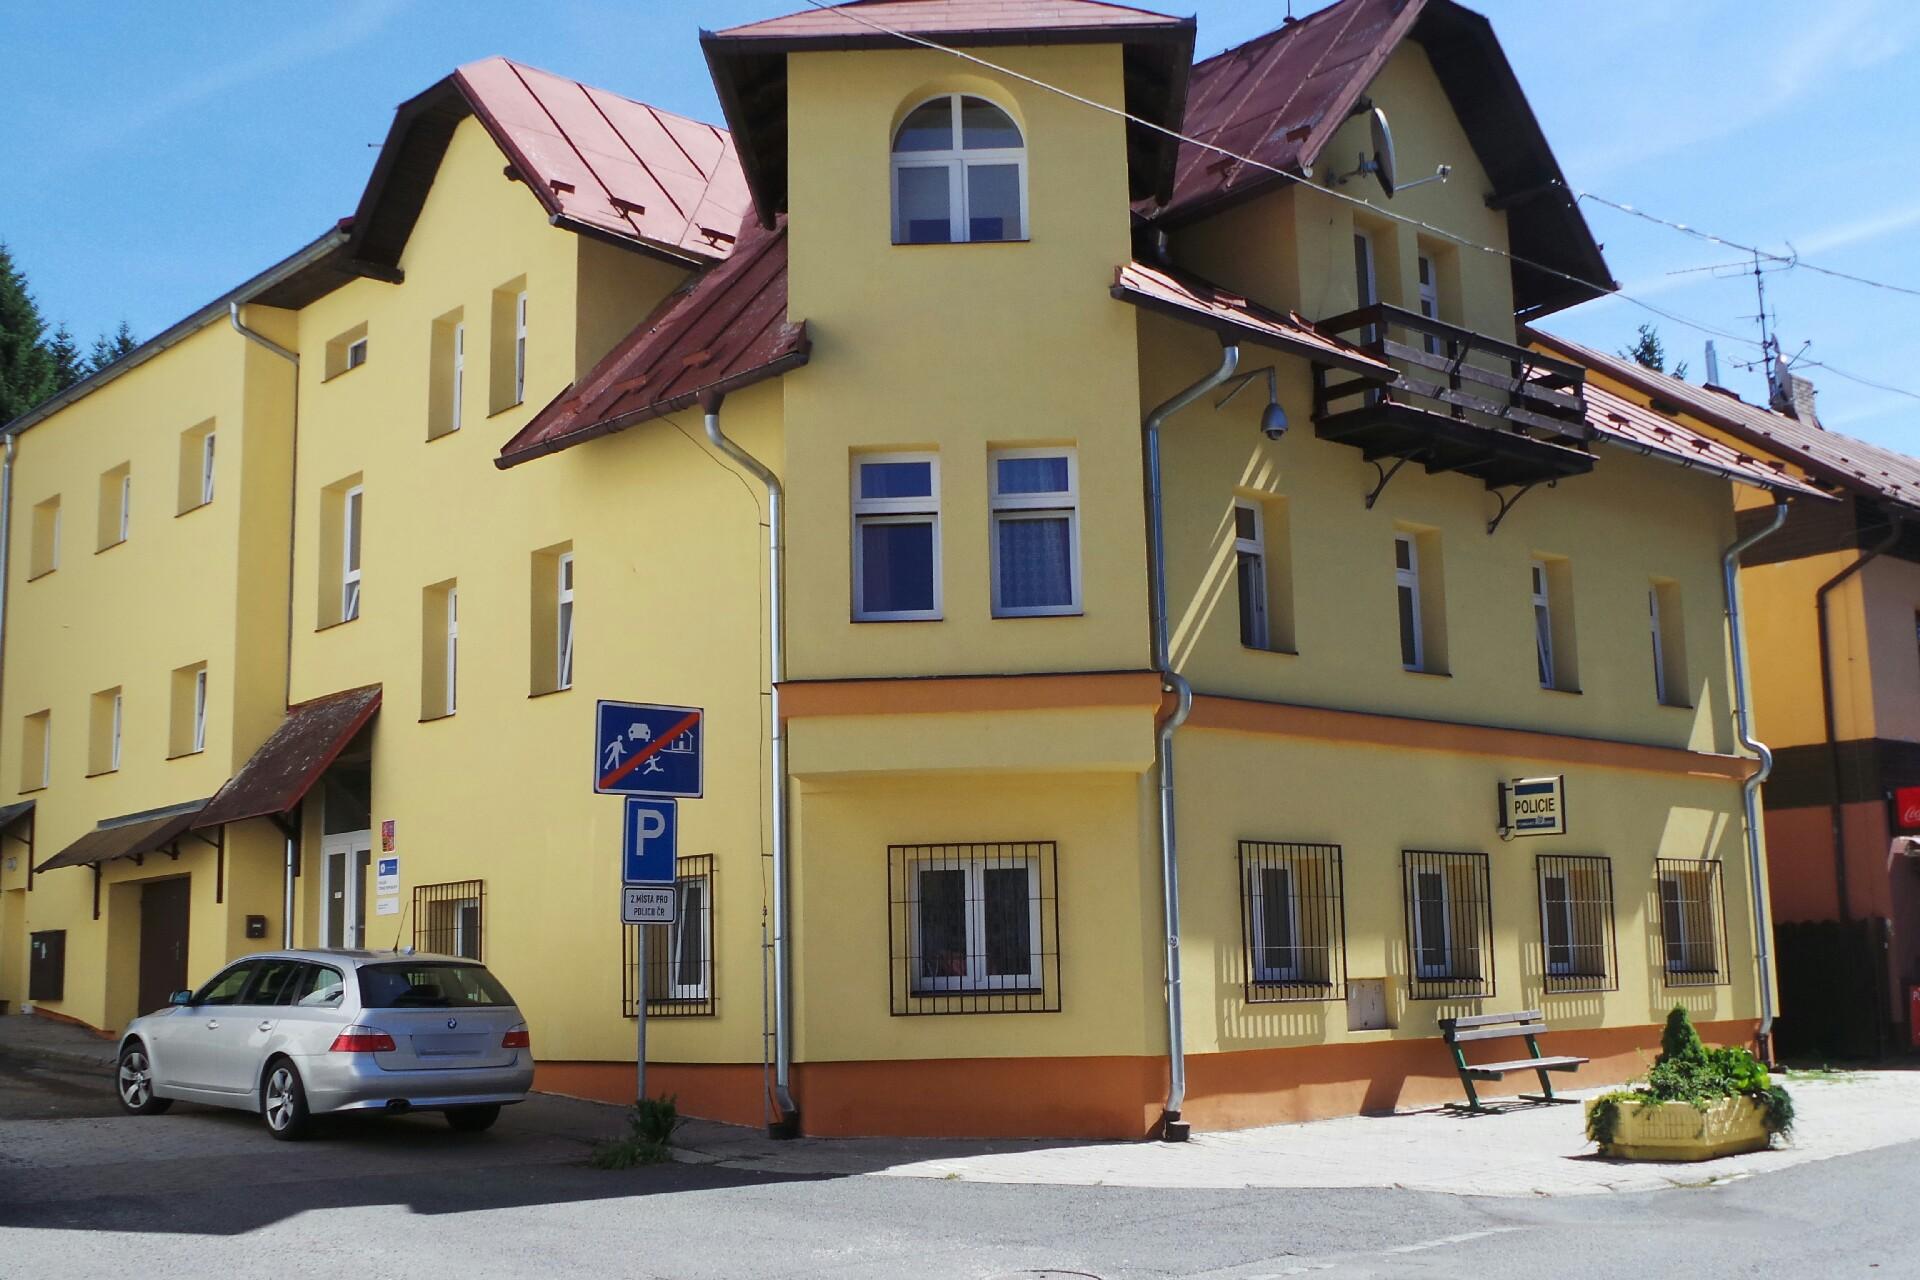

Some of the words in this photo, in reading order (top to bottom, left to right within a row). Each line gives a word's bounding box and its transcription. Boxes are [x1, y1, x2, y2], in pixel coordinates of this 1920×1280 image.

[1514, 797, 1555, 814] POLICIE
[636, 808, 665, 856] P
[630, 894, 635, 903] 2
[656, 895, 668, 904] PRO
